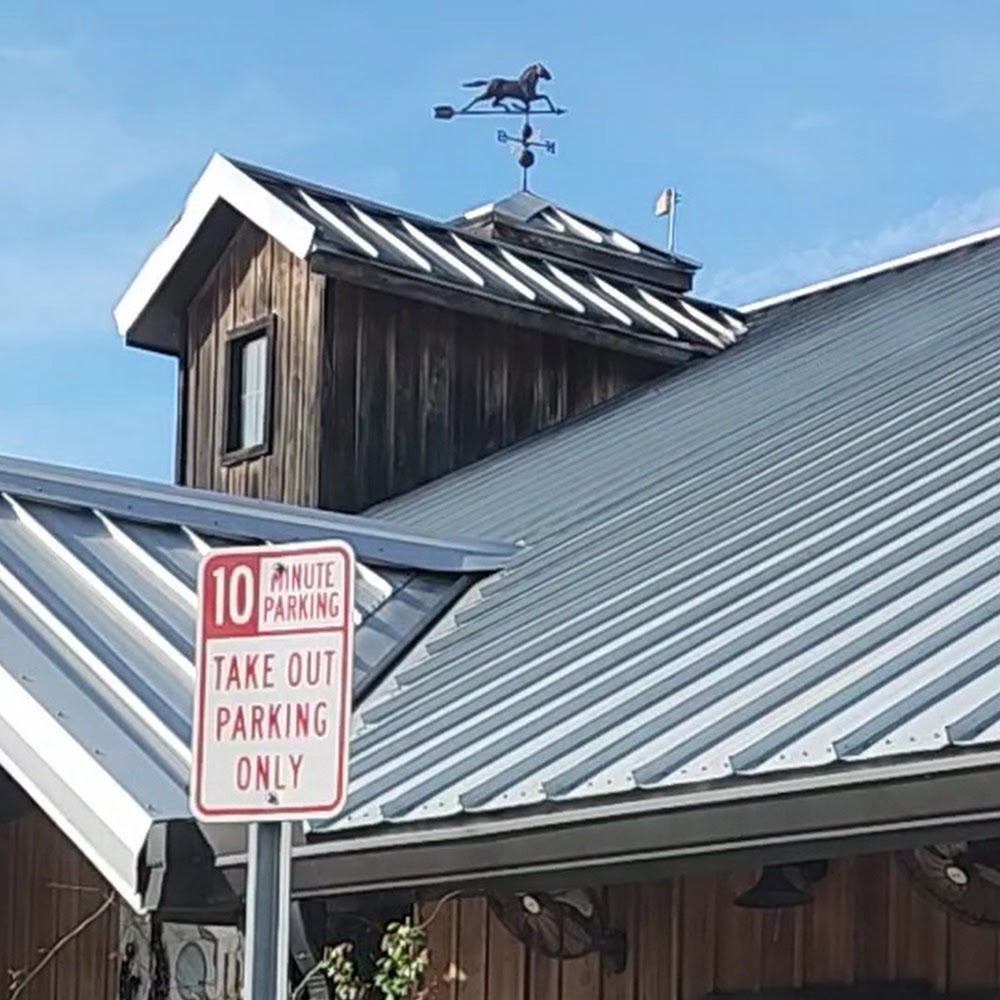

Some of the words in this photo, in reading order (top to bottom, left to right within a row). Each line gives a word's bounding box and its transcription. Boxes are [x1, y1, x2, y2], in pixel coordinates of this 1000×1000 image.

[212, 565, 254, 626] 10
[271, 561, 335, 593] MINUTE
[264, 592, 339, 622] PARKING
[213, 653, 275, 690] TAKE
[288, 651, 335, 687] OUT
[216, 702, 327, 741] PARKING
[237, 754, 303, 791] ONLY
